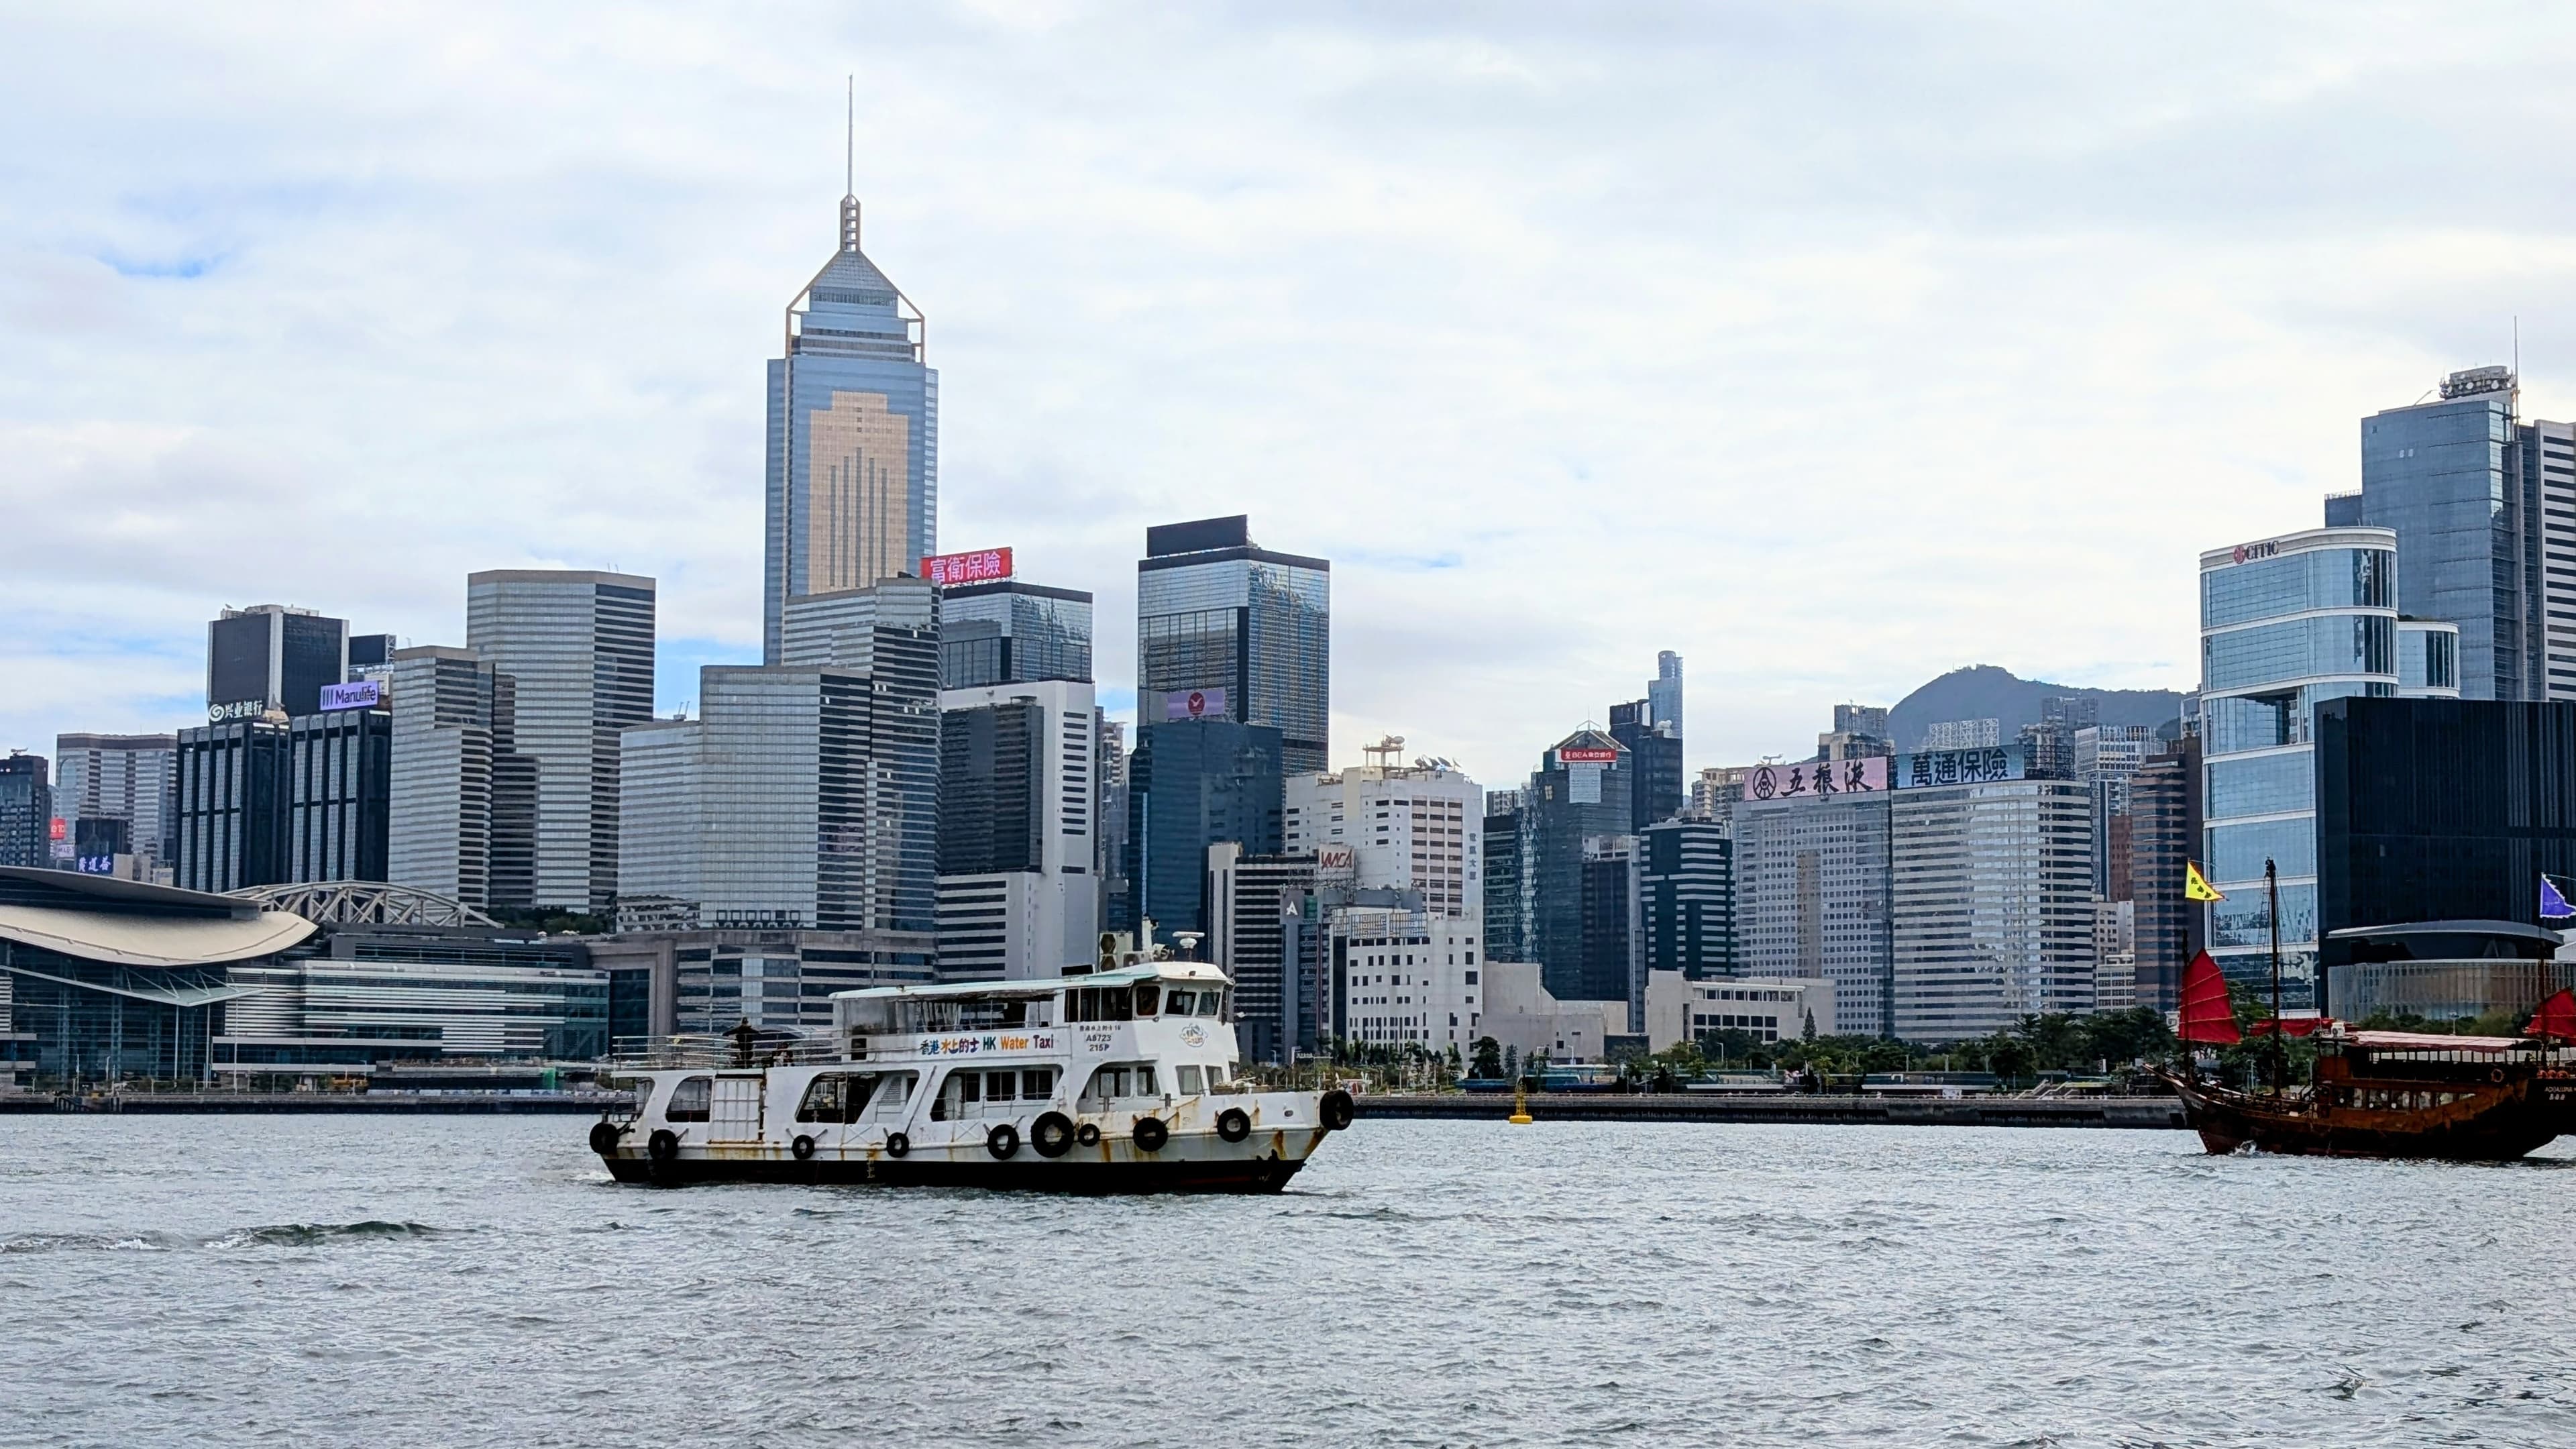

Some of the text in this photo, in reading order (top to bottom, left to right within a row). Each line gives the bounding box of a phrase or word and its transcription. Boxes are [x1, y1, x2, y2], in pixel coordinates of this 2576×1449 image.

[2247, 541, 2279, 559] CITIC
[930, 551, 1001, 582] 富衛保險
[336, 685, 376, 704] Manulife
[225, 700, 263, 718] 兴业银行
[1911, 749, 2009, 786] 萬通保險
[1780, 761, 1874, 797] 五粮液
[920, 1033, 1054, 1055] 香港水上的士 HK Water Taxi
